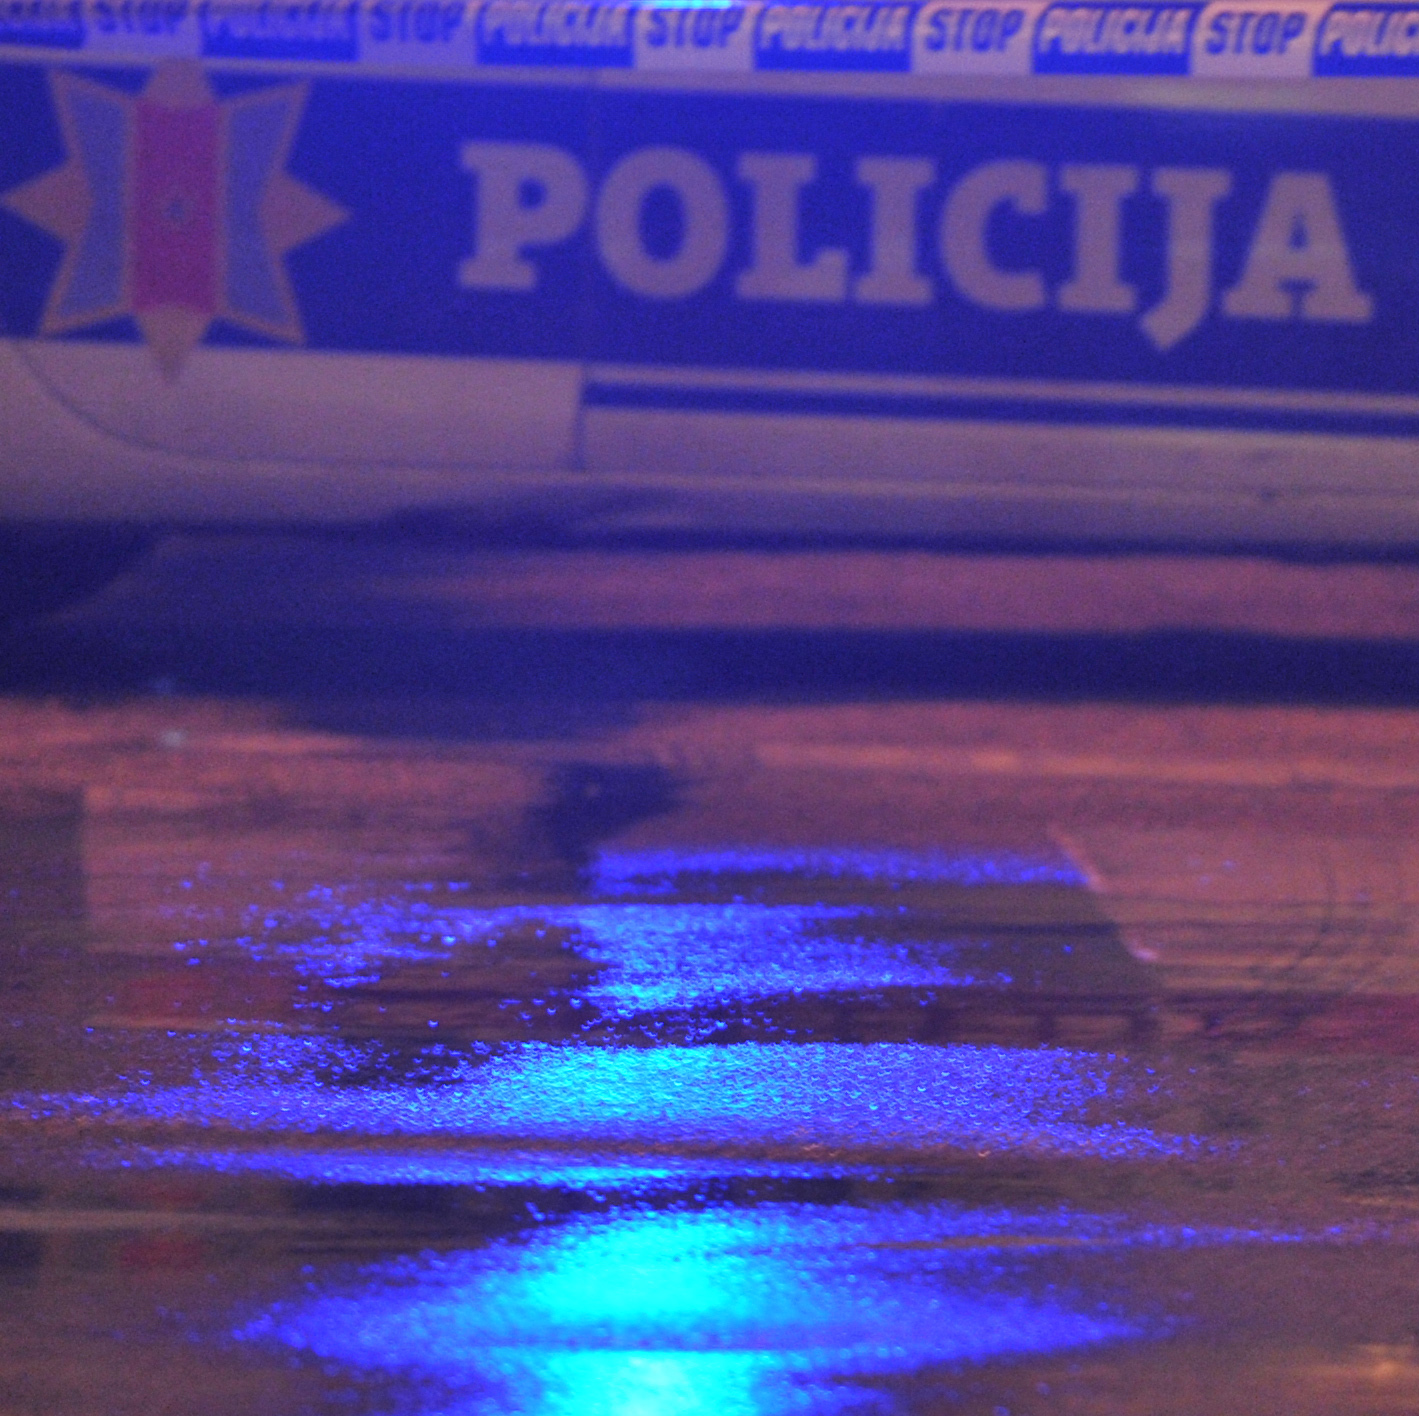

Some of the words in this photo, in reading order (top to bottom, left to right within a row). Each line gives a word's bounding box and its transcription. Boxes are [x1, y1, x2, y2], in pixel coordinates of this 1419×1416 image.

[369, 0, 466, 42] STOP
[647, 5, 745, 48] STOP
[761, 5, 908, 50] POLICIJA
[925, 7, 1026, 51] STOP
[1042, 7, 1195, 54] POLICIJA
[1206, 11, 1308, 55] STOP
[457, 140, 1375, 351] POLICIJA
